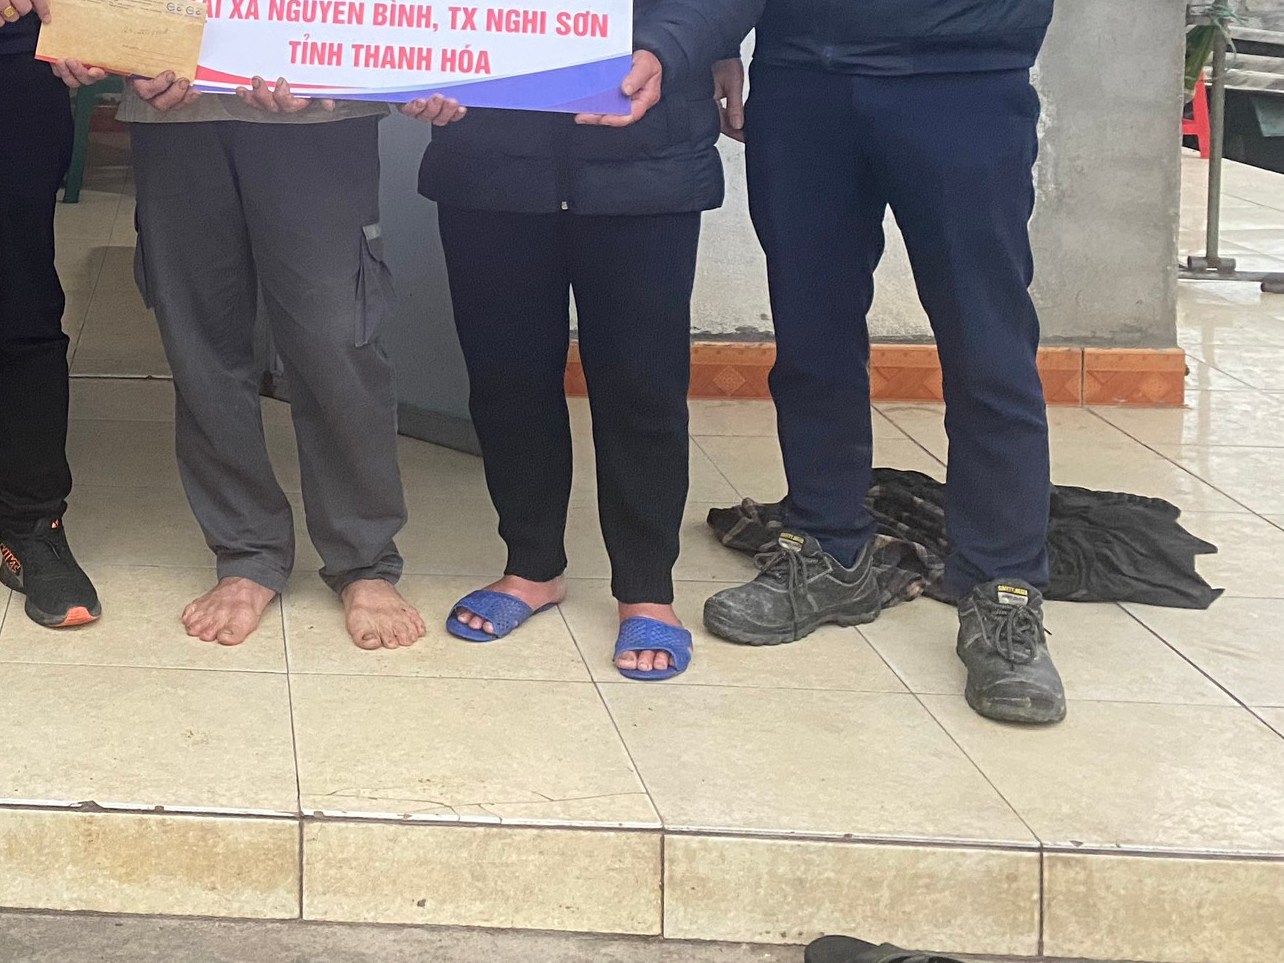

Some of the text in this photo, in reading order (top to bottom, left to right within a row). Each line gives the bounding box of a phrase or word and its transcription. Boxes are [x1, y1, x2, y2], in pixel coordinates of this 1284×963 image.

[448, 6, 478, 32] TX
[486, 8, 547, 35] NGHI
[555, 10, 608, 38] SƠN
[289, 33, 491, 75] TỈNH THANH HÓA
